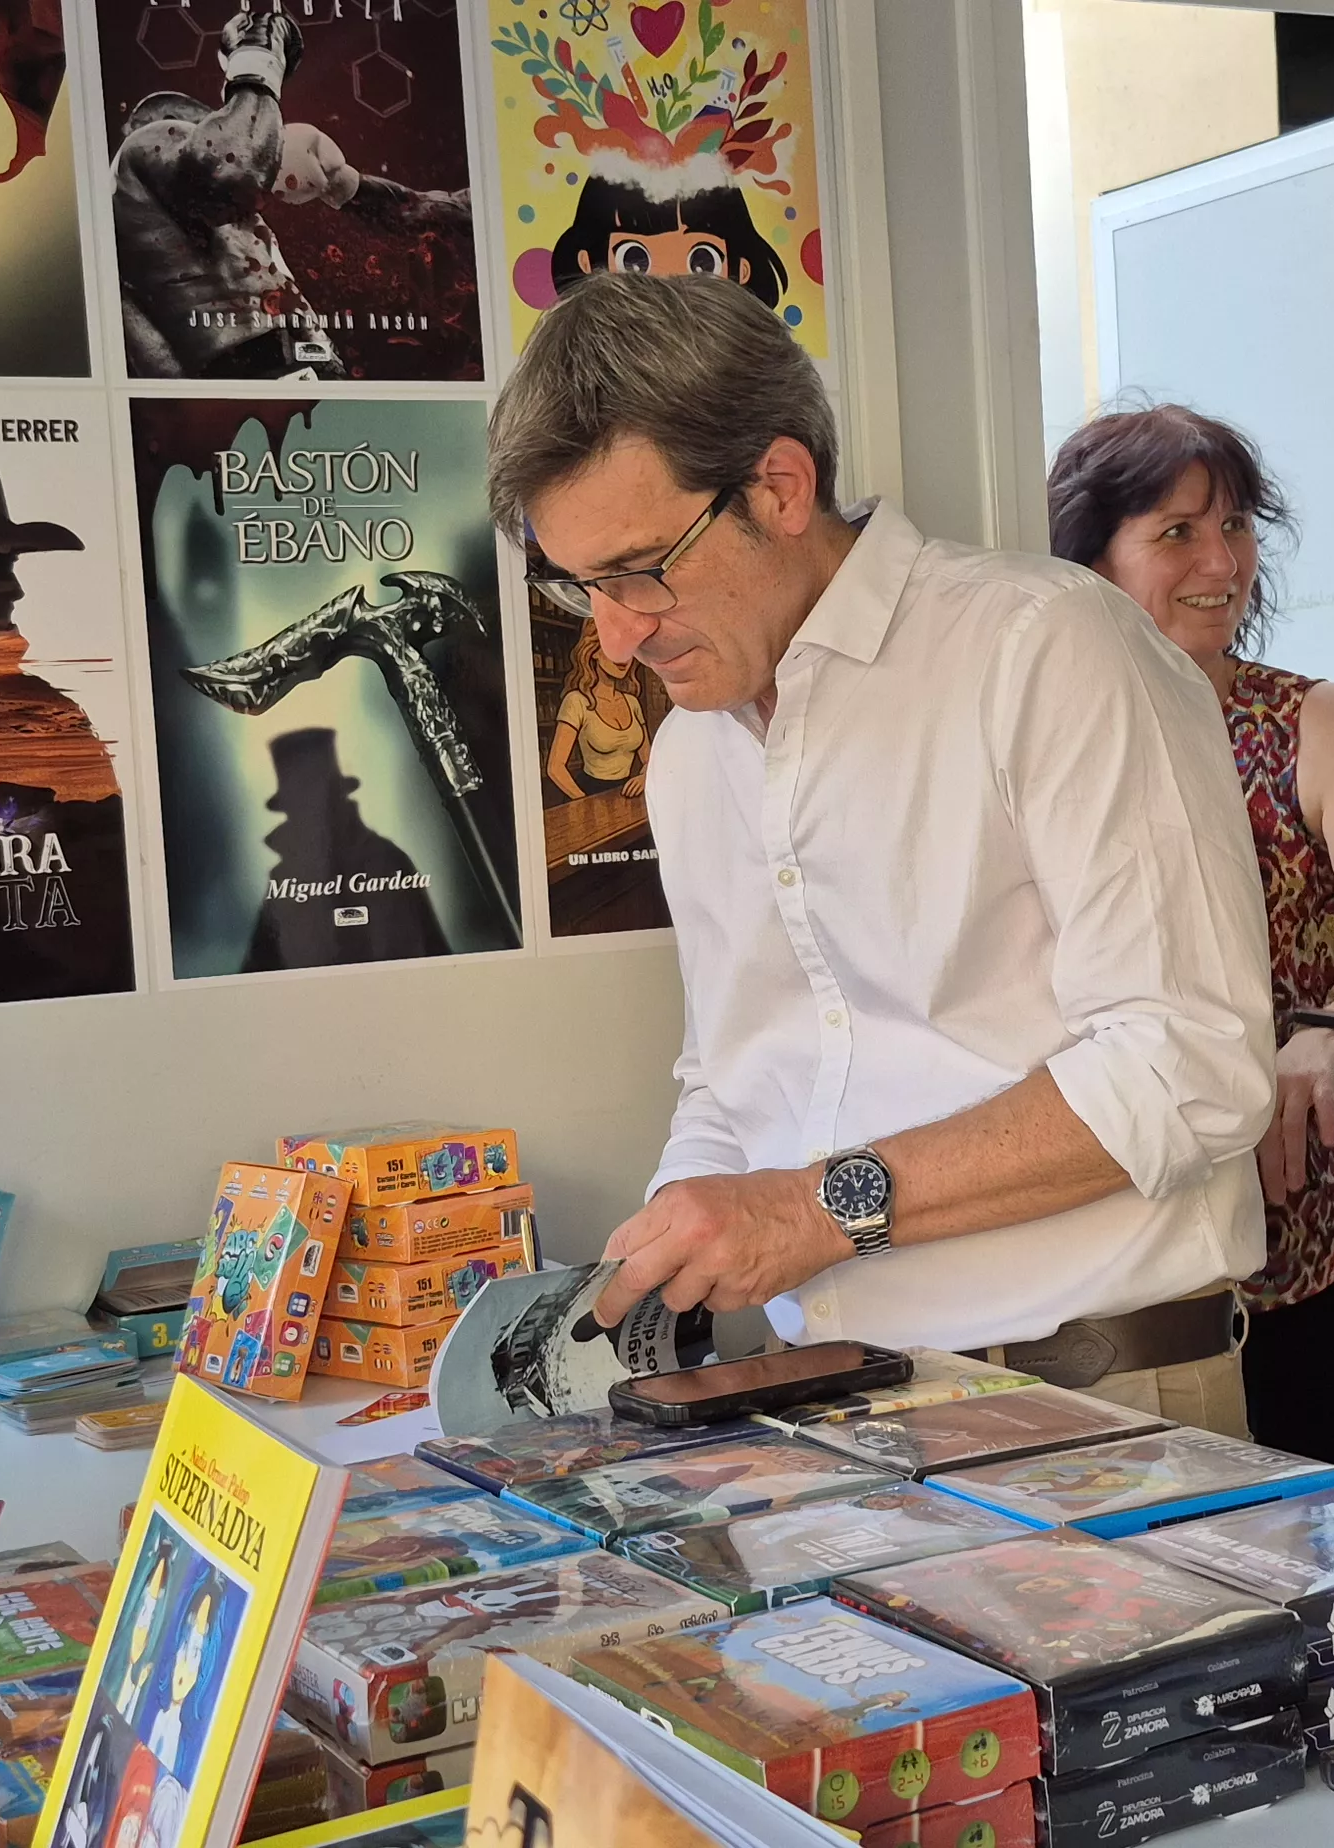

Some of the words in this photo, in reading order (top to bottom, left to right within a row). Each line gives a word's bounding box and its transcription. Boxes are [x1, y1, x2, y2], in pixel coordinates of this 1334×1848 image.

[213, 443, 420, 494] BASTÓN
[302, 496, 336, 517] DE
[232, 510, 414, 563] ÉBANO
[568, 853, 588, 866] UN
[592, 850, 629, 864] LIBRO
[267, 875, 342, 903] Miguel
[349, 870, 432, 893] Gardeta
[386, 1159, 404, 1172] 151
[416, 1277, 433, 1292] 151
[422, 1338, 437, 1352] 151
[798, 1620, 926, 1674] TENNIS
[753, 1632, 879, 1686] CARDS
[1207, 1657, 1240, 1674] Colabora
[1122, 1681, 1159, 1698] Patrocina
[1124, 1717, 1170, 1740] ZAMORA
[972, 1753, 989, 1769] +6
[1203, 1745, 1236, 1762] Colabora
[896, 1773, 924, 1793] 2-4
[1117, 1770, 1154, 1788] Patrocina
[830, 1794, 846, 1810] 15
[1120, 1807, 1166, 1829] ZAMORA
